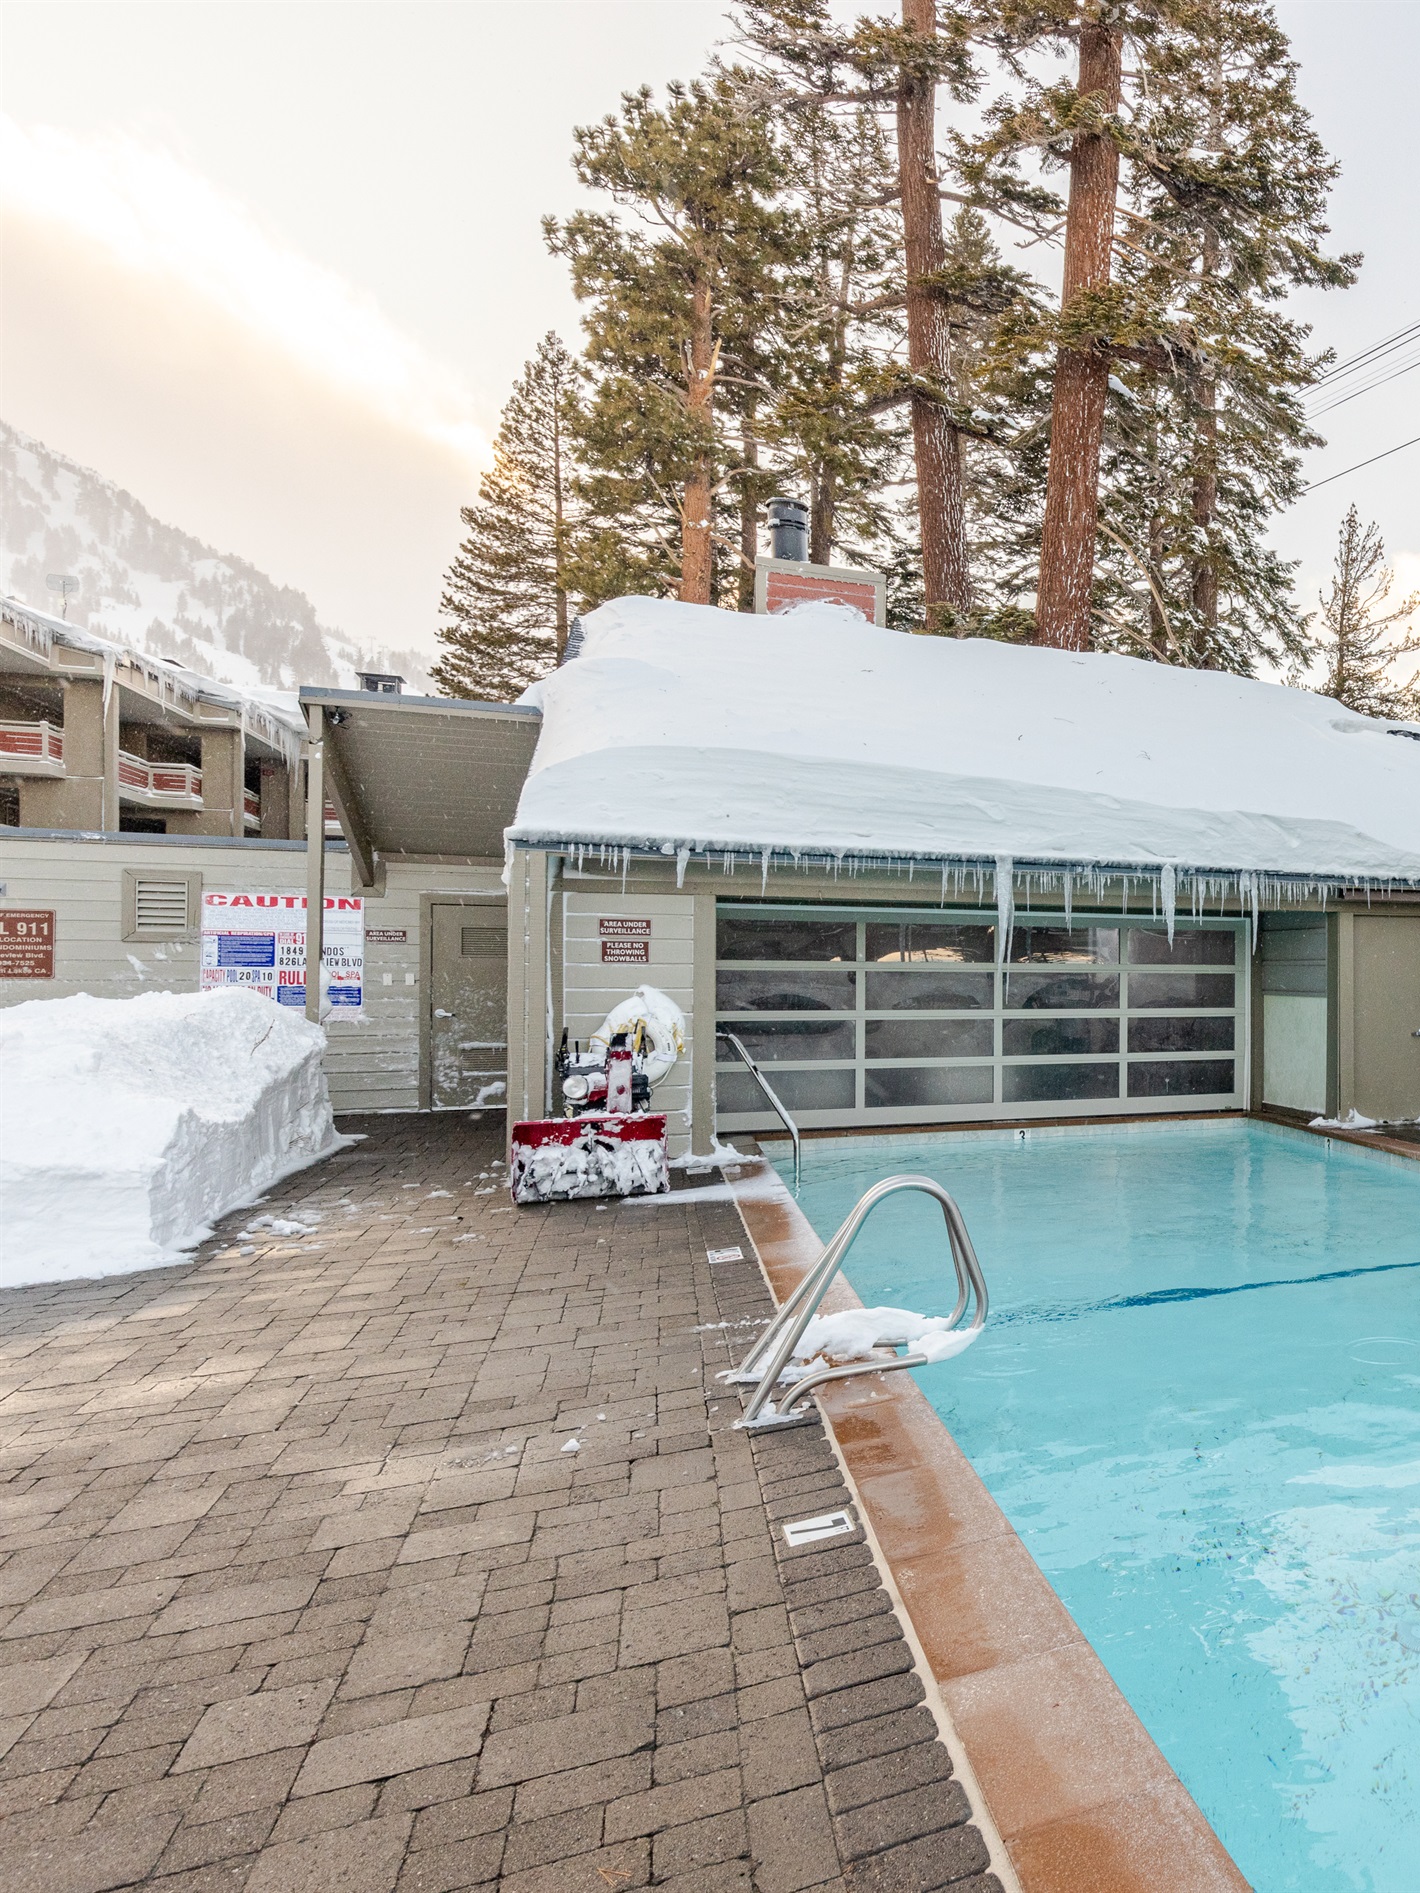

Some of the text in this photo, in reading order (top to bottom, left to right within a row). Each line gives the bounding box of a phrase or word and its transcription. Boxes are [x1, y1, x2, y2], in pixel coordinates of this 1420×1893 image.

[17, 922, 48, 935] 911
[281, 947, 304, 955] 1849
[342, 958, 362, 967] BLVD
[203, 969, 225, 982] CAPACITY
[227, 970, 238, 982] POOL
[239, 972, 251, 980] 20
[790, 1517, 846, 1535] 7
